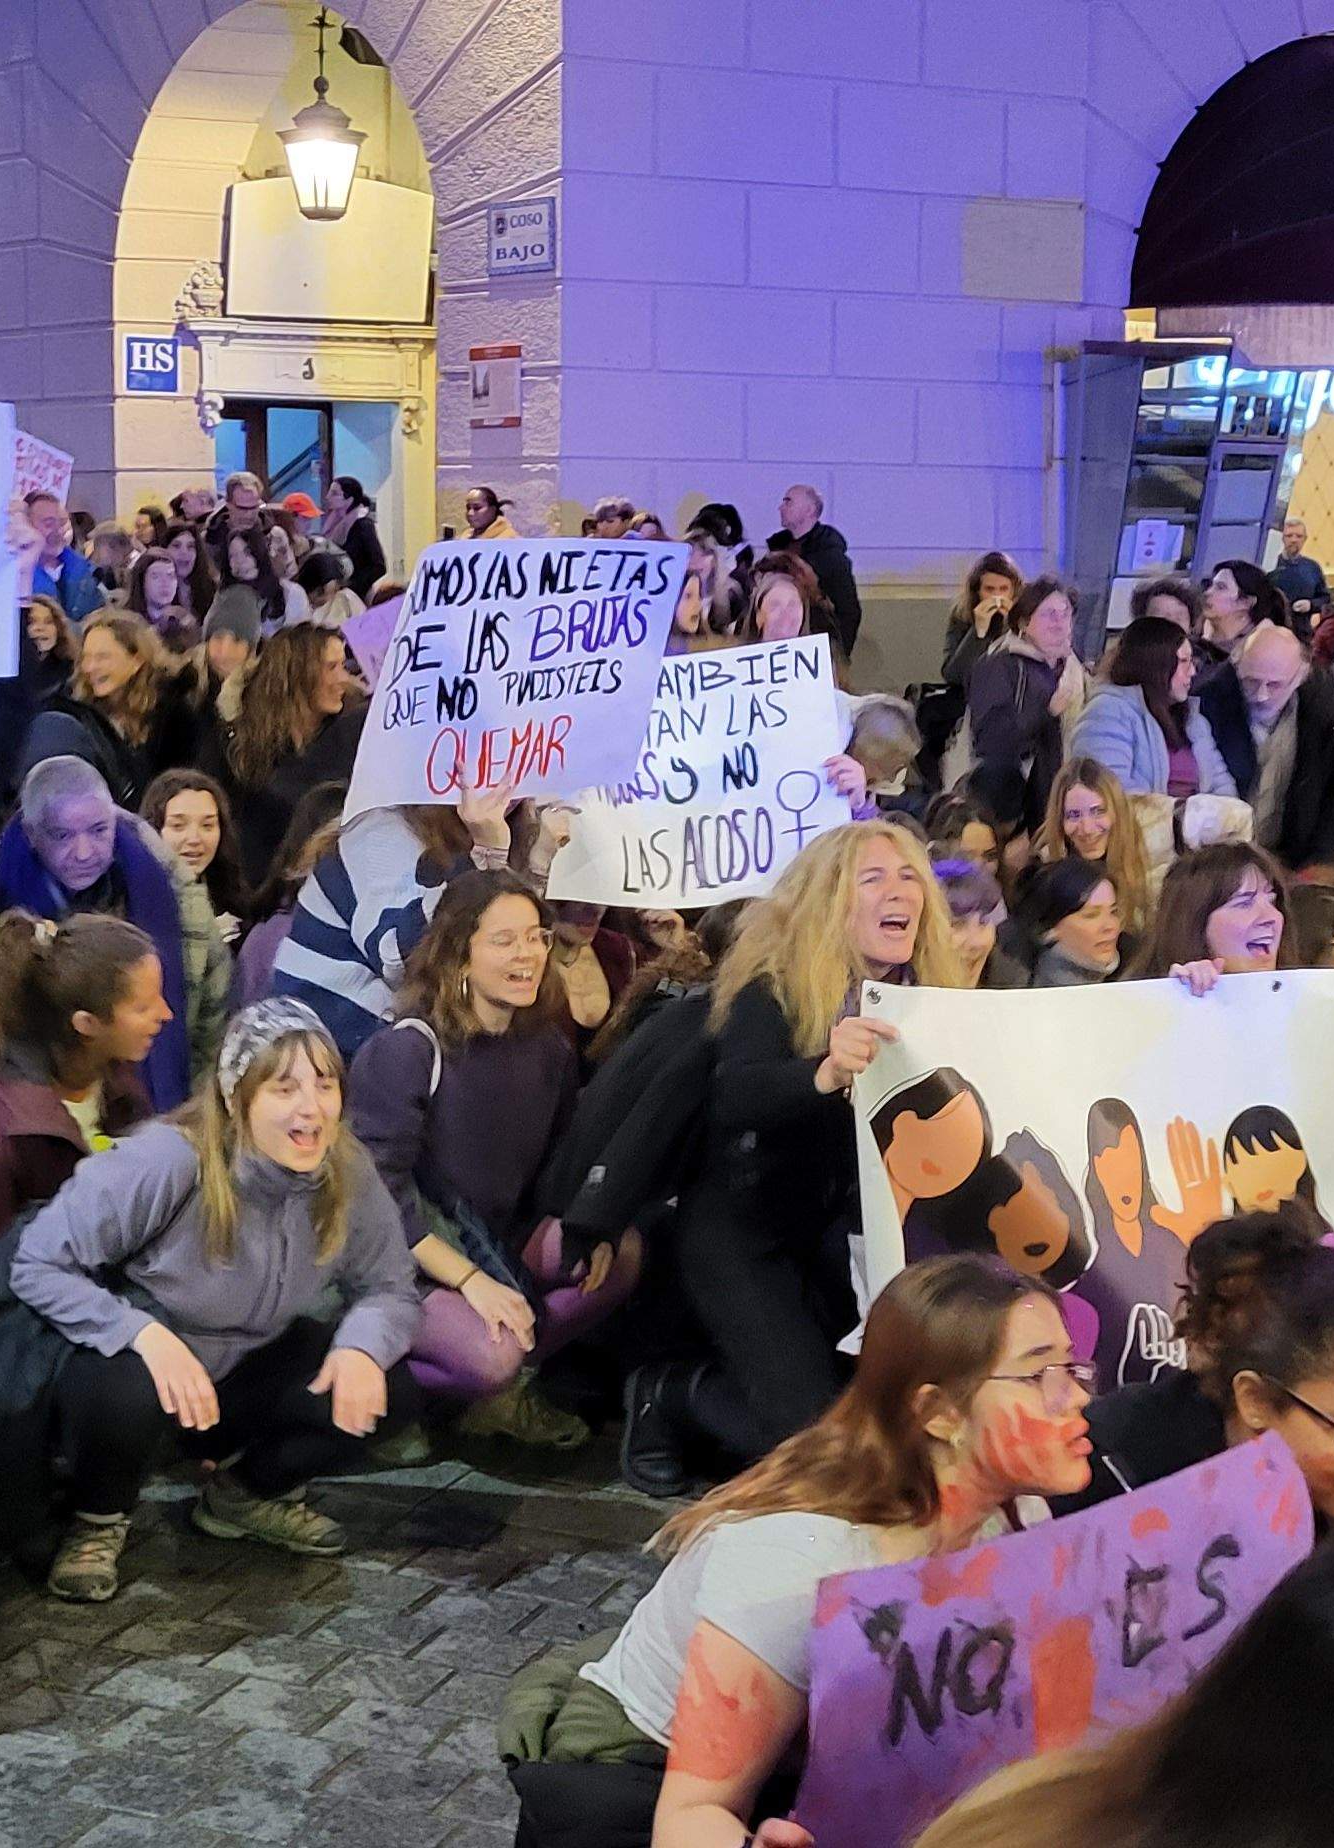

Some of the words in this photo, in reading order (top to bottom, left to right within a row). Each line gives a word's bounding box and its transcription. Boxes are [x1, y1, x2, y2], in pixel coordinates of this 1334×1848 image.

[509, 211, 543, 230] COSO
[495, 243, 545, 262] BAJO
[129, 341, 174, 373] HS
[479, 550, 530, 602] LAS
[538, 549, 675, 597] NIETAS
[386, 623, 447, 692] DE
[464, 608, 511, 675] LAS
[524, 592, 652, 663] BRUJAS
[383, 685, 430, 731] QUE
[436, 676, 479, 725] NO
[498, 659, 623, 707] PUDISTEIS
[656, 643, 819, 701] AMBIÉN
[726, 689, 788, 737] LAS
[425, 715, 574, 796] QUEMAR
[722, 741, 759, 794] NO
[622, 828, 673, 893] LAS
[680, 806, 774, 898] ACOSO
[887, 1614, 1017, 1750] NO
[1107, 1533, 1242, 1669] ES
